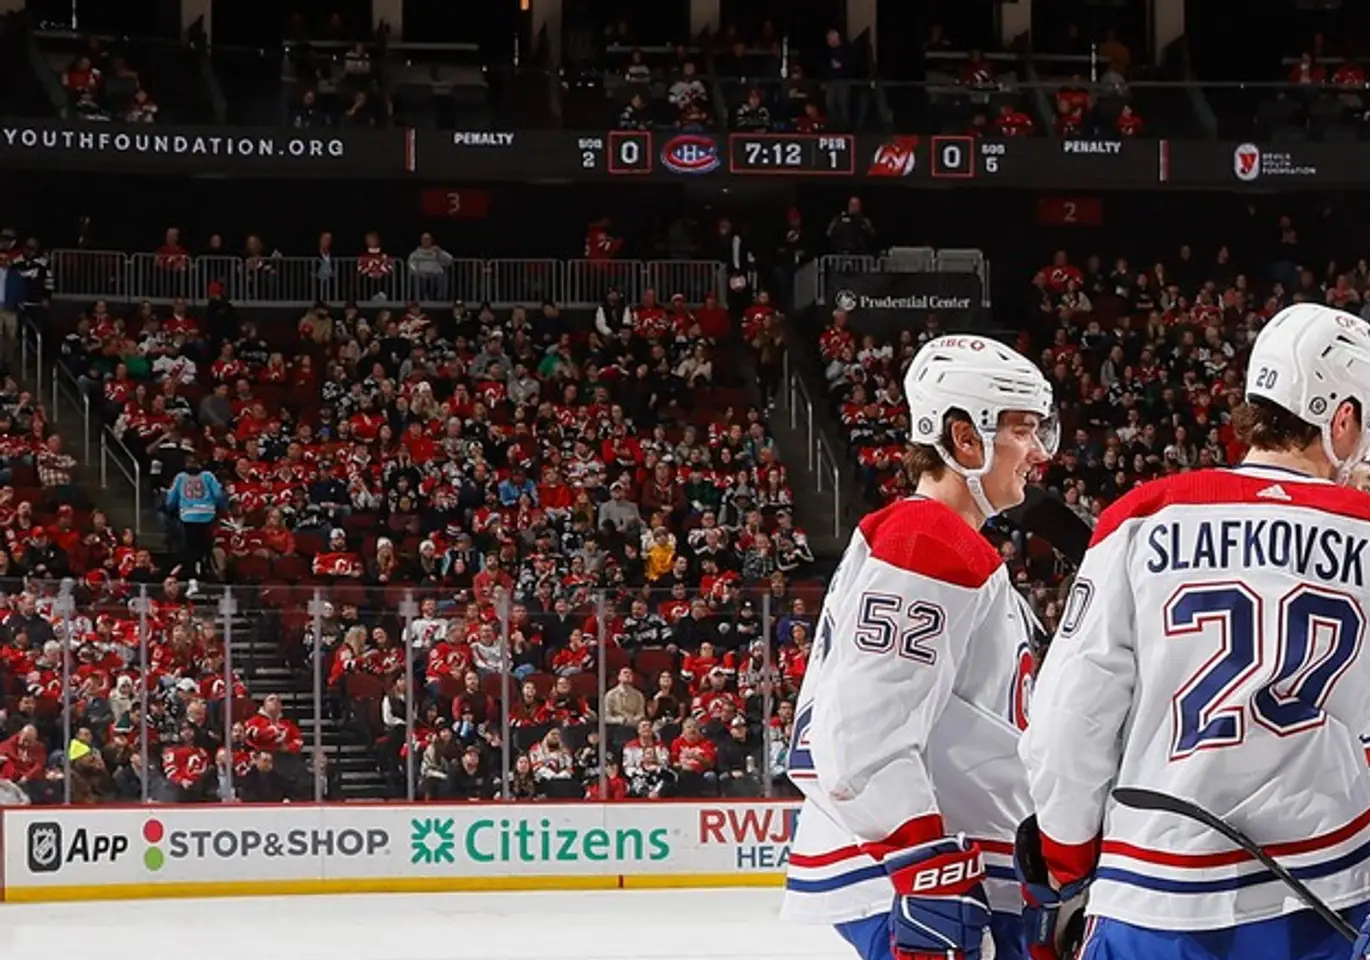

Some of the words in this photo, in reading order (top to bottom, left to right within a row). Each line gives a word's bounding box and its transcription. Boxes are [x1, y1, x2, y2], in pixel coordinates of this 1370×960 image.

[3, 128, 345, 157] YOUTHFOUNDATION.ORG
[453, 132, 514, 145] PENALTY
[818, 138, 846, 150] PER
[1063, 140, 1122, 154] PENALTY
[582, 151, 595, 168] 2
[619, 140, 639, 165] 0
[744, 142, 802, 165] 7:12
[828, 150, 839, 169] 1
[942, 146, 961, 169] 0
[985, 157, 999, 173] 5
[446, 192, 461, 214] 3
[1062, 202, 1078, 223] 2
[859, 294, 928, 310] Prudential
[929, 295, 972, 310] Center
[1255, 366, 1279, 391] 20
[854, 591, 947, 666] 52
[1163, 580, 1367, 763] 20
[66, 828, 129, 863] App
[169, 828, 390, 859] STOP&SHOP
[464, 817, 671, 863] Citizens
